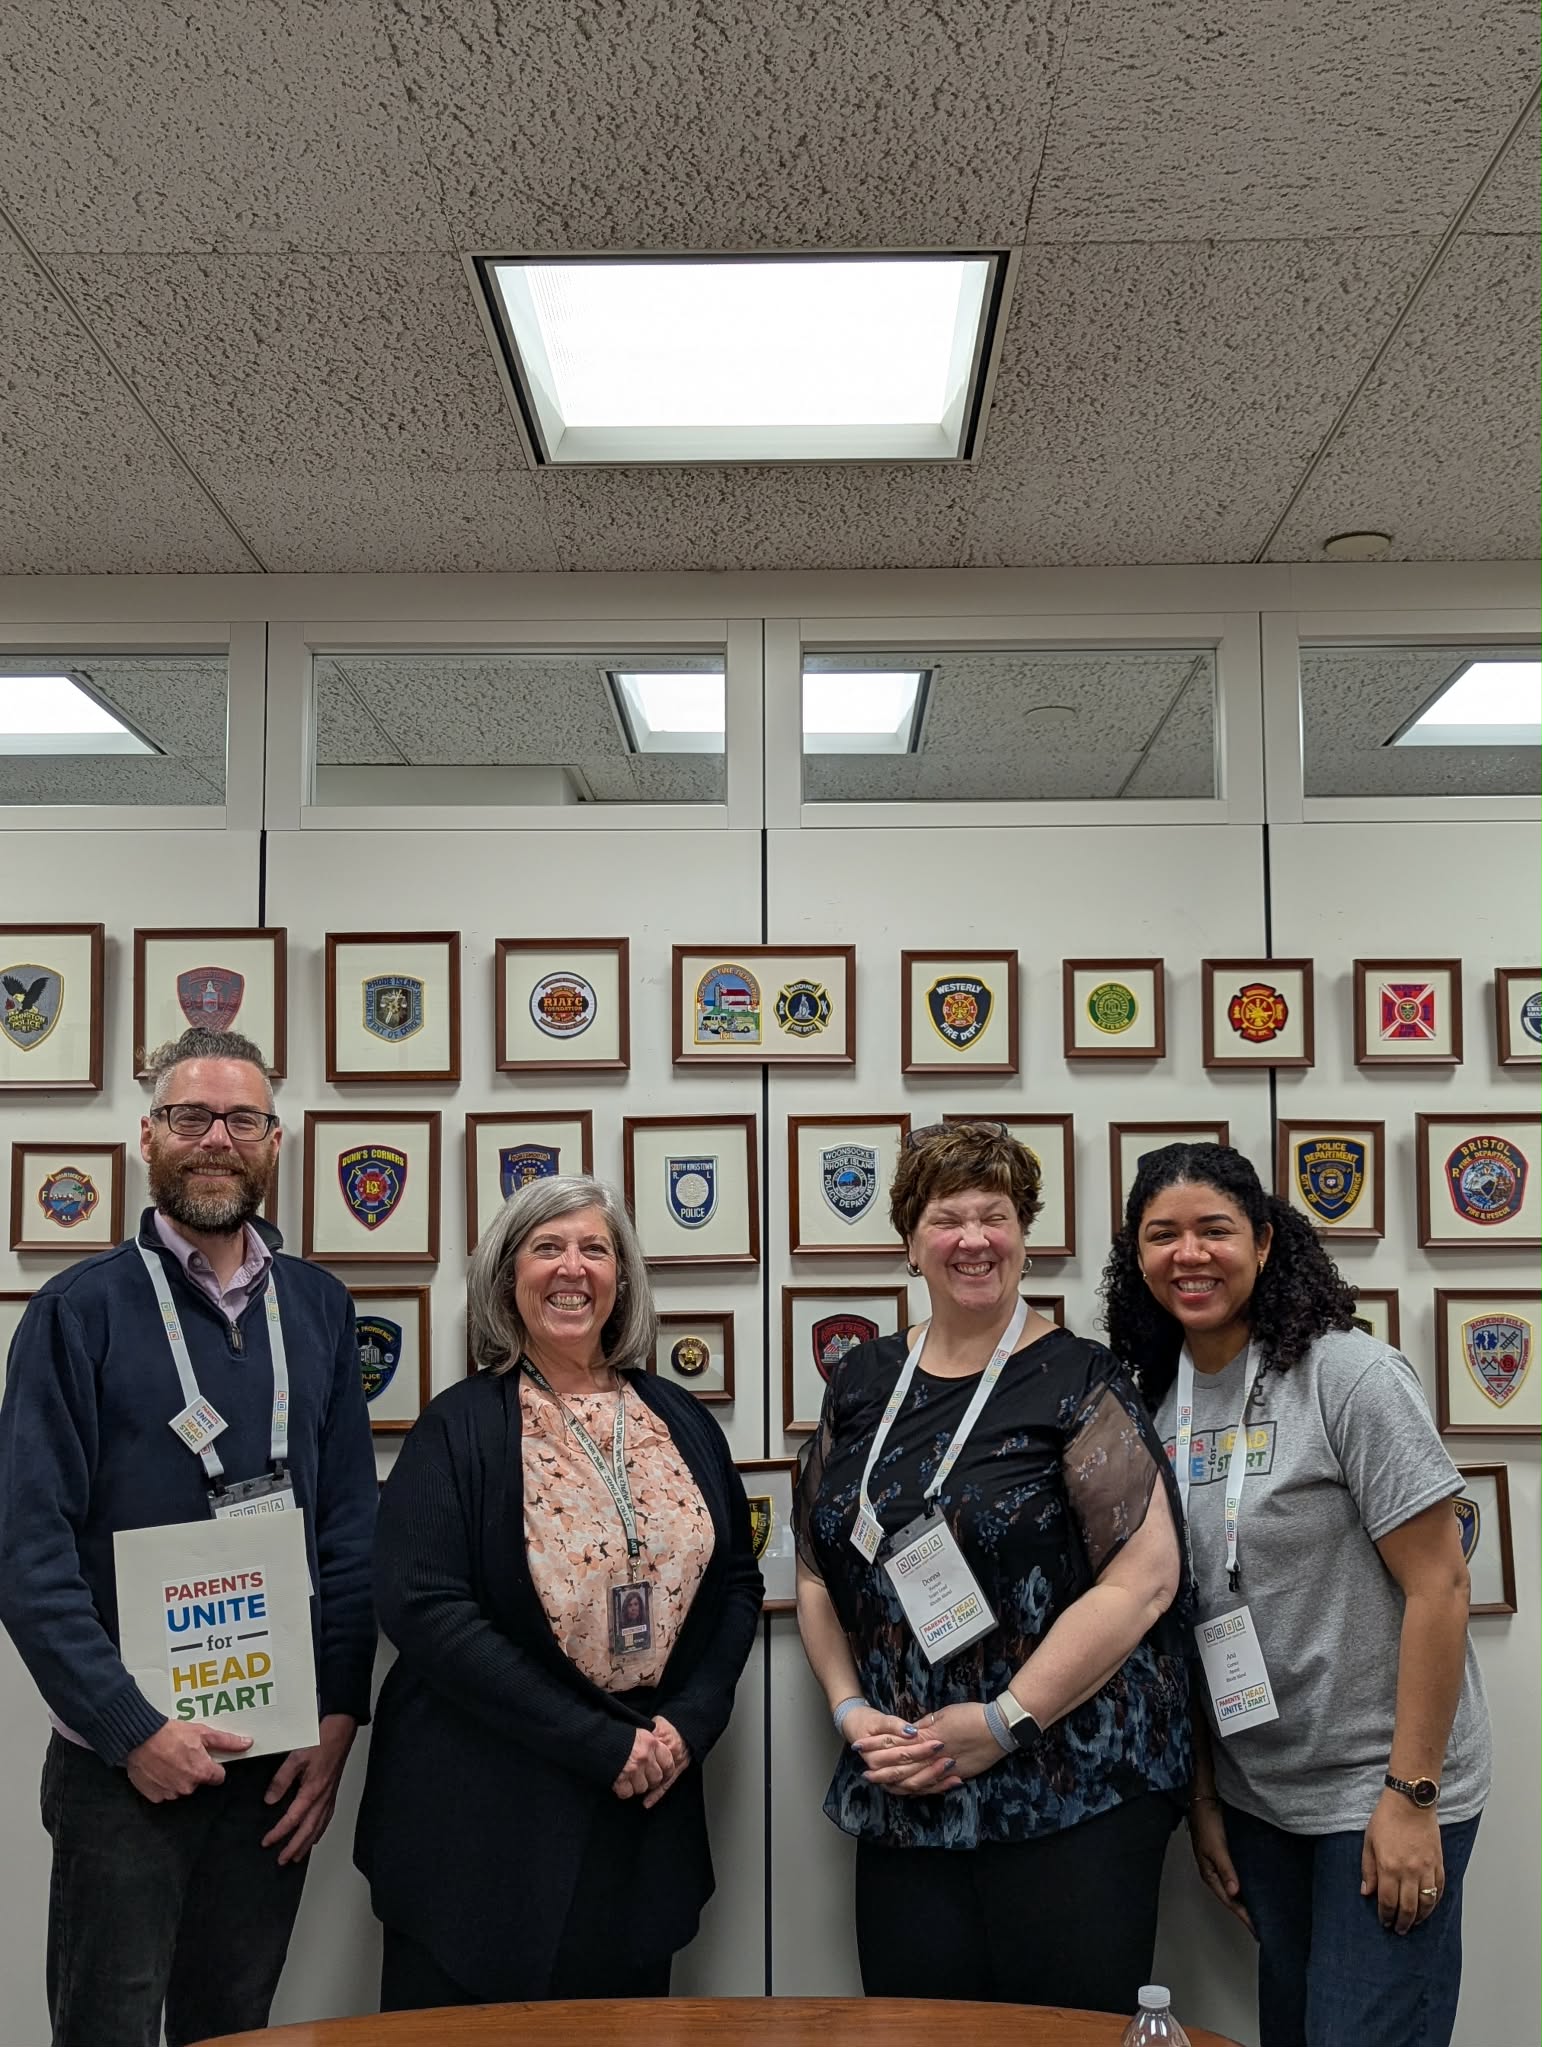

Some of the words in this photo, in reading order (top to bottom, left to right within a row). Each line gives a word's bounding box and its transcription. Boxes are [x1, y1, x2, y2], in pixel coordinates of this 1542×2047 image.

[367, 978, 393, 990] RHODE
[394, 978, 420, 990] ISLAND
[936, 983, 983, 995] WESTERLY
[543, 998, 583, 1007] RIAFC
[940, 1022, 959, 1040] FIRE
[825, 1147, 875, 1160] WOONSOCKET
[1316, 1143, 1347, 1151] POLICE
[1460, 1139, 1511, 1156] BRISTOL
[342, 1149, 368, 1167] DUNN'S
[371, 1149, 404, 1166] CORNERS
[824, 1158, 849, 1171] RHODE
[850, 1158, 875, 1169] ISLAND
[1304, 1151, 1359, 1163] DEPARTMENT
[1452, 1167, 1460, 1178] R
[42, 1190, 48, 1201] F
[824, 1174, 840, 1204] POLICE
[839, 1173, 875, 1209] DEPARTMENT
[680, 1208, 705, 1218] POLICE
[196, 1409, 215, 1430] UNITE
[179, 1424, 199, 1444] START
[185, 1418, 204, 1440] HEAD
[1216, 1451, 1267, 1473] STRT
[165, 1571, 263, 1603] PARENTS
[167, 1593, 267, 1633] UNITE
[953, 1597, 976, 1617] HEAD
[957, 1605, 980, 1623] START
[926, 1621, 955, 1643] UNITE
[206, 1634, 232, 1651] for
[172, 1651, 271, 1693] HEAD
[176, 1682, 274, 1721] START
[1245, 1687, 1265, 1699] HEAD
[1247, 1695, 1267, 1708] START
[1220, 1702, 1243, 1717] UNITE
